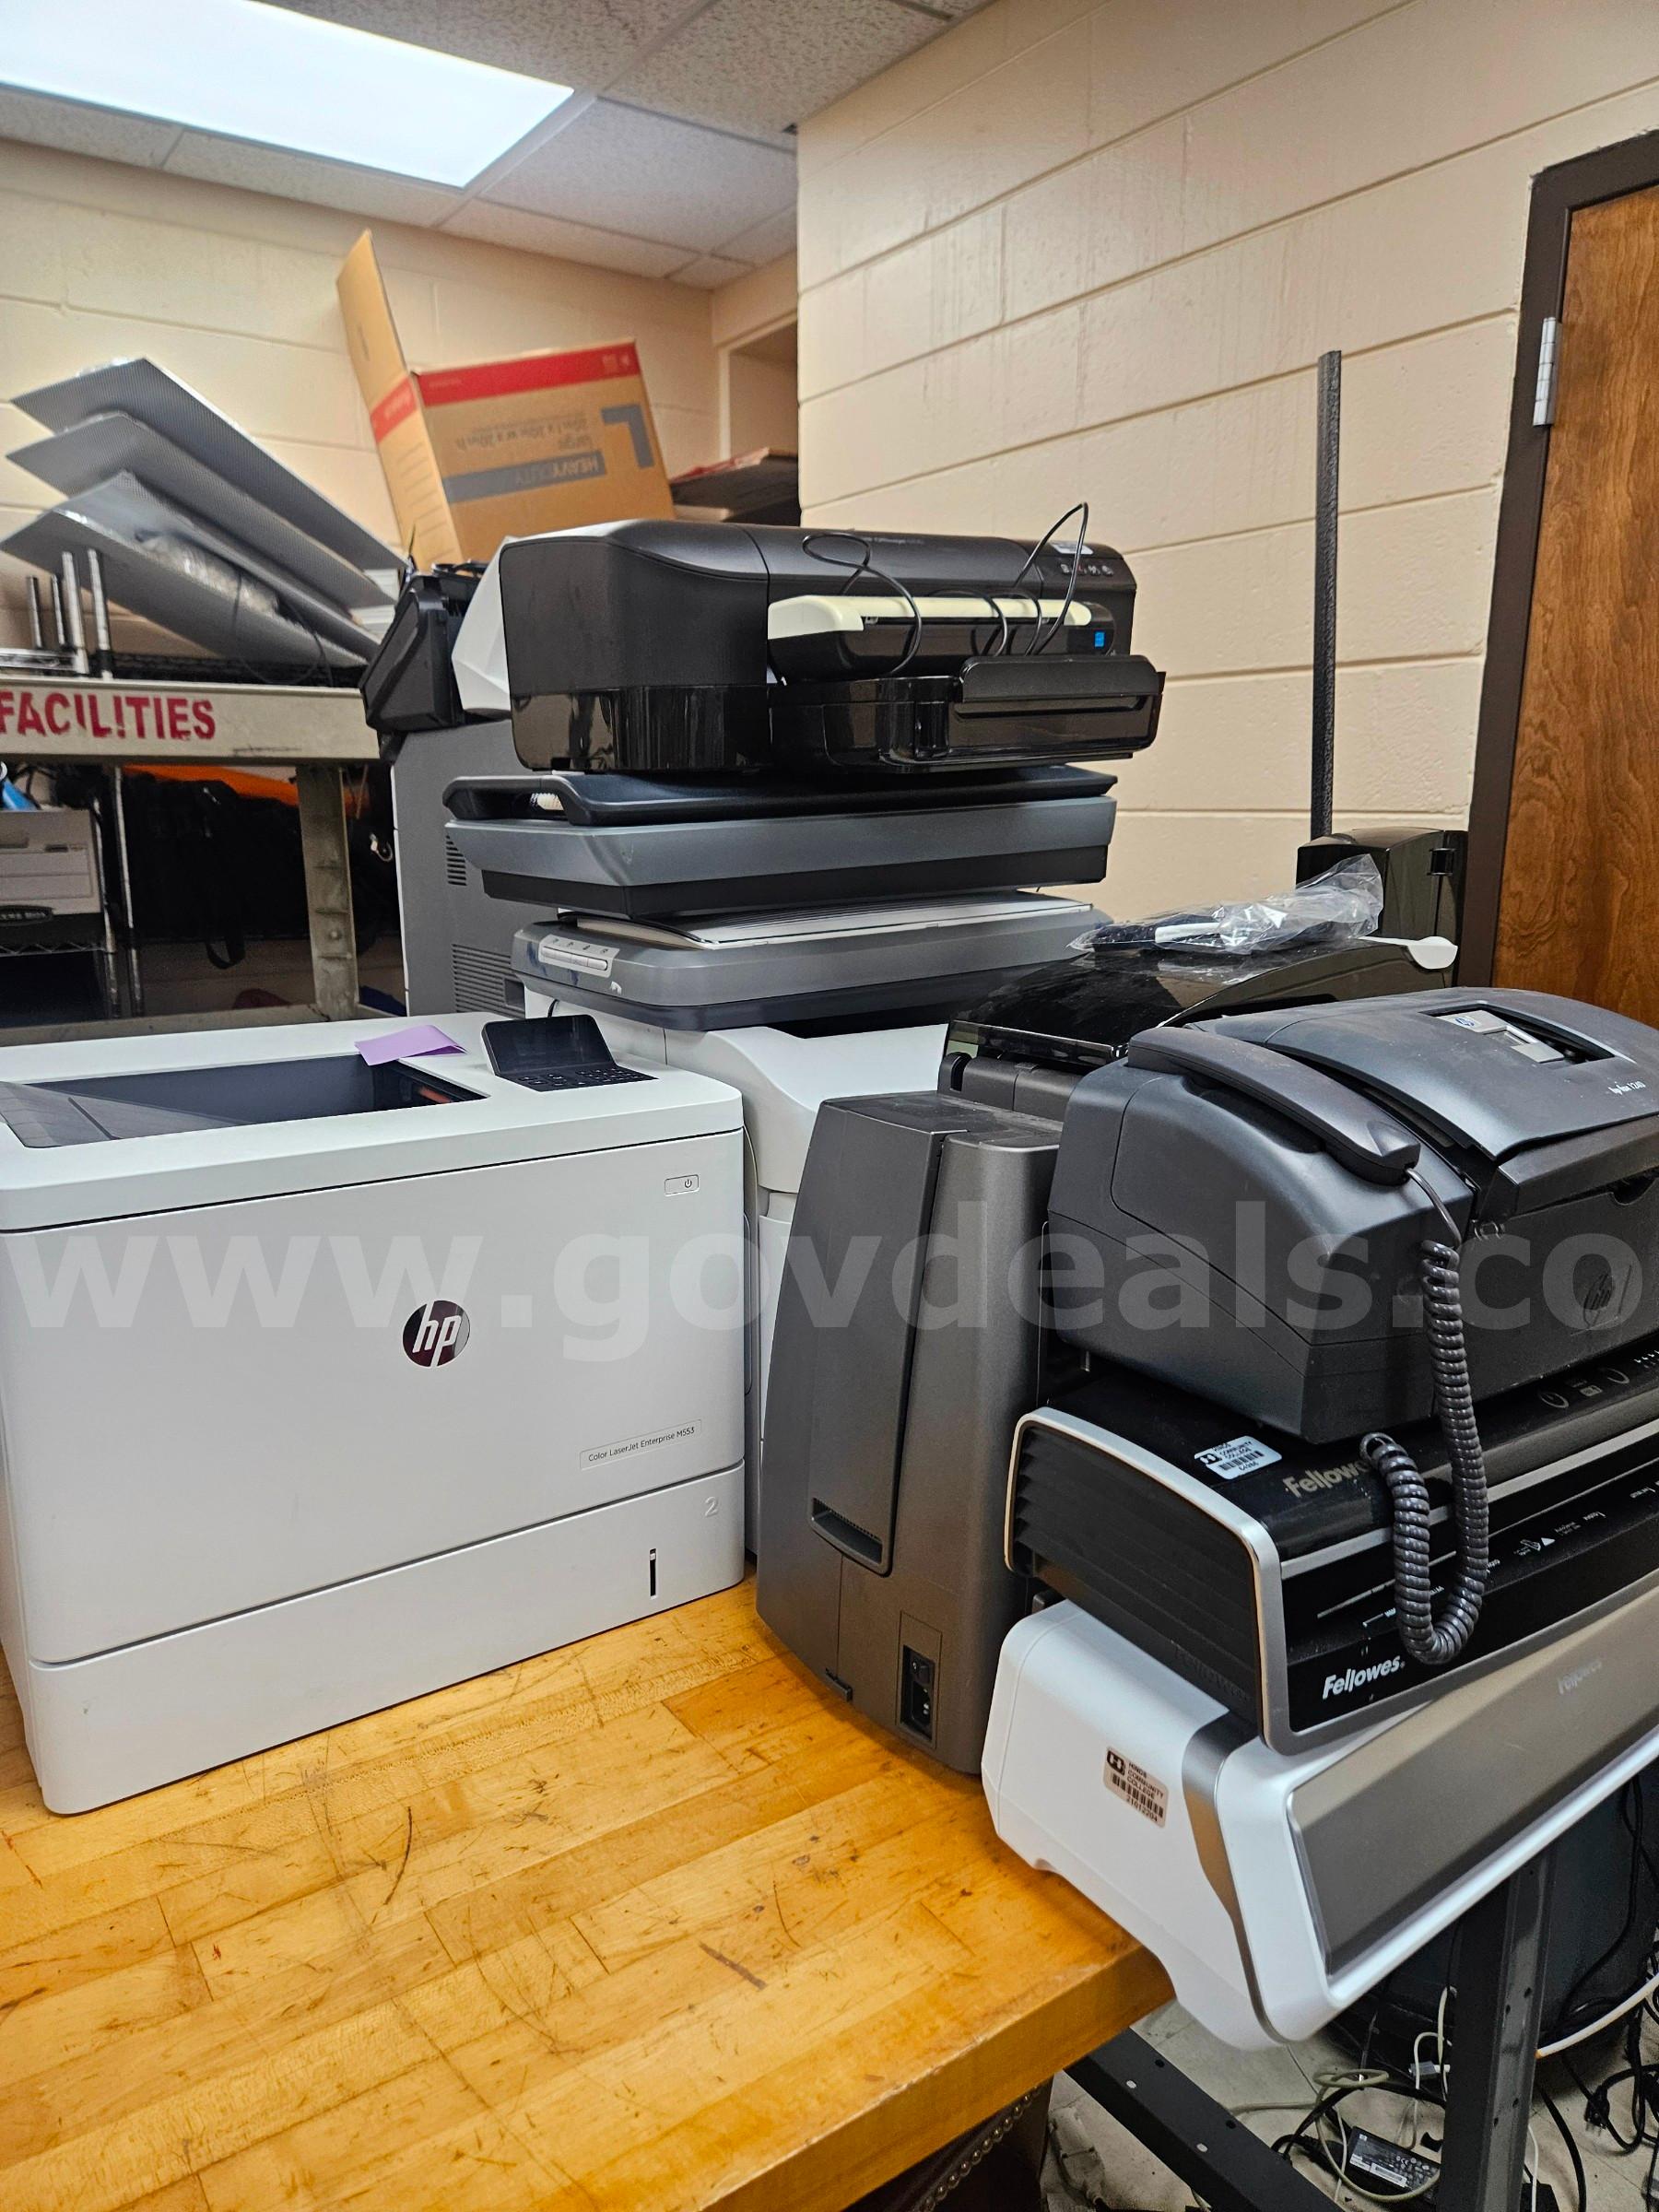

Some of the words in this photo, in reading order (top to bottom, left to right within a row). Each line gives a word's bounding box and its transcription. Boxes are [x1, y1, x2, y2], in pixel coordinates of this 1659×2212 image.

[553, 454, 600, 478] HEAVY
[409, 1298, 464, 1369] hp
[588, 1451, 607, 1462] Color
[609, 1441, 639, 1457] LaserJet
[641, 1432, 675, 1448] Enterprise
[677, 1426, 695, 1438] M553
[704, 1496, 719, 1517] 2
